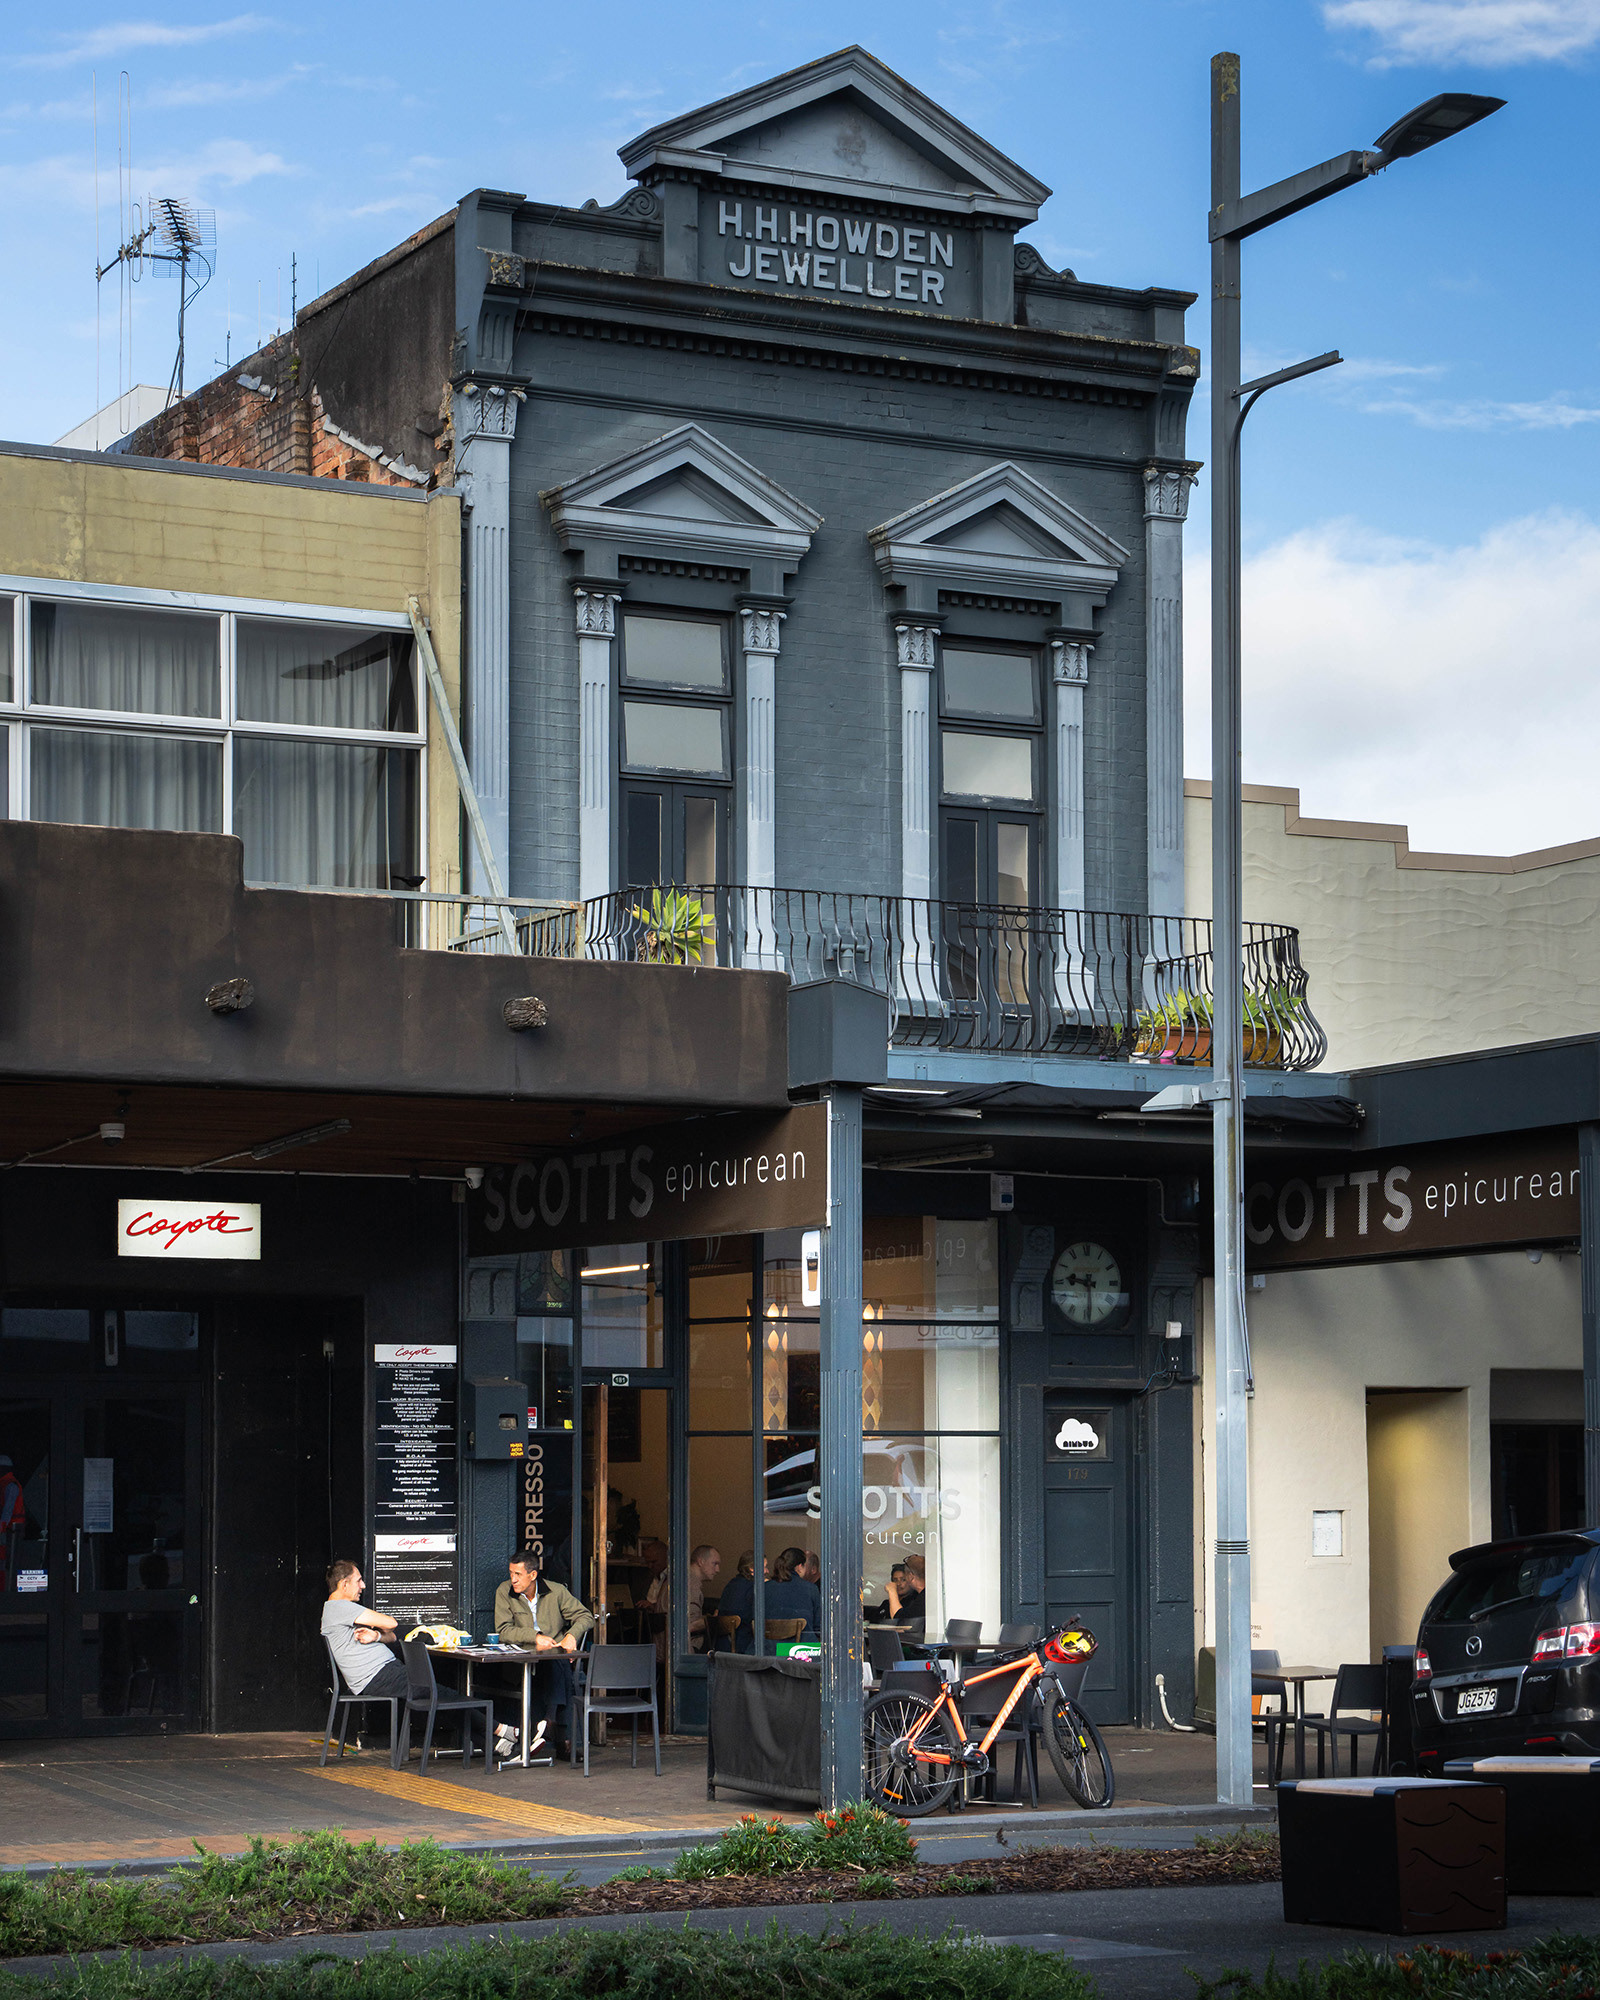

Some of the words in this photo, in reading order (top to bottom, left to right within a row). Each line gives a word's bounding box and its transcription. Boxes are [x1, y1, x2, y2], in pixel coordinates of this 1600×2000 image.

[729, 244, 945, 305] JEWELLER
[483, 1144, 655, 1232] SCOTTS
[665, 1150, 806, 1202] epicurean
[1246, 1165, 1413, 1245] COTTS
[126, 1210, 254, 1250] Coyote
[395, 1347, 437, 1360] Coyote
[525, 1444, 544, 1570] SPRESSO
[806, 1485, 962, 1520] SOTTS
[397, 1537, 434, 1549] Coyote
[865, 1531, 938, 1544] curean
[1459, 1691, 1496, 1709] JGZ573
